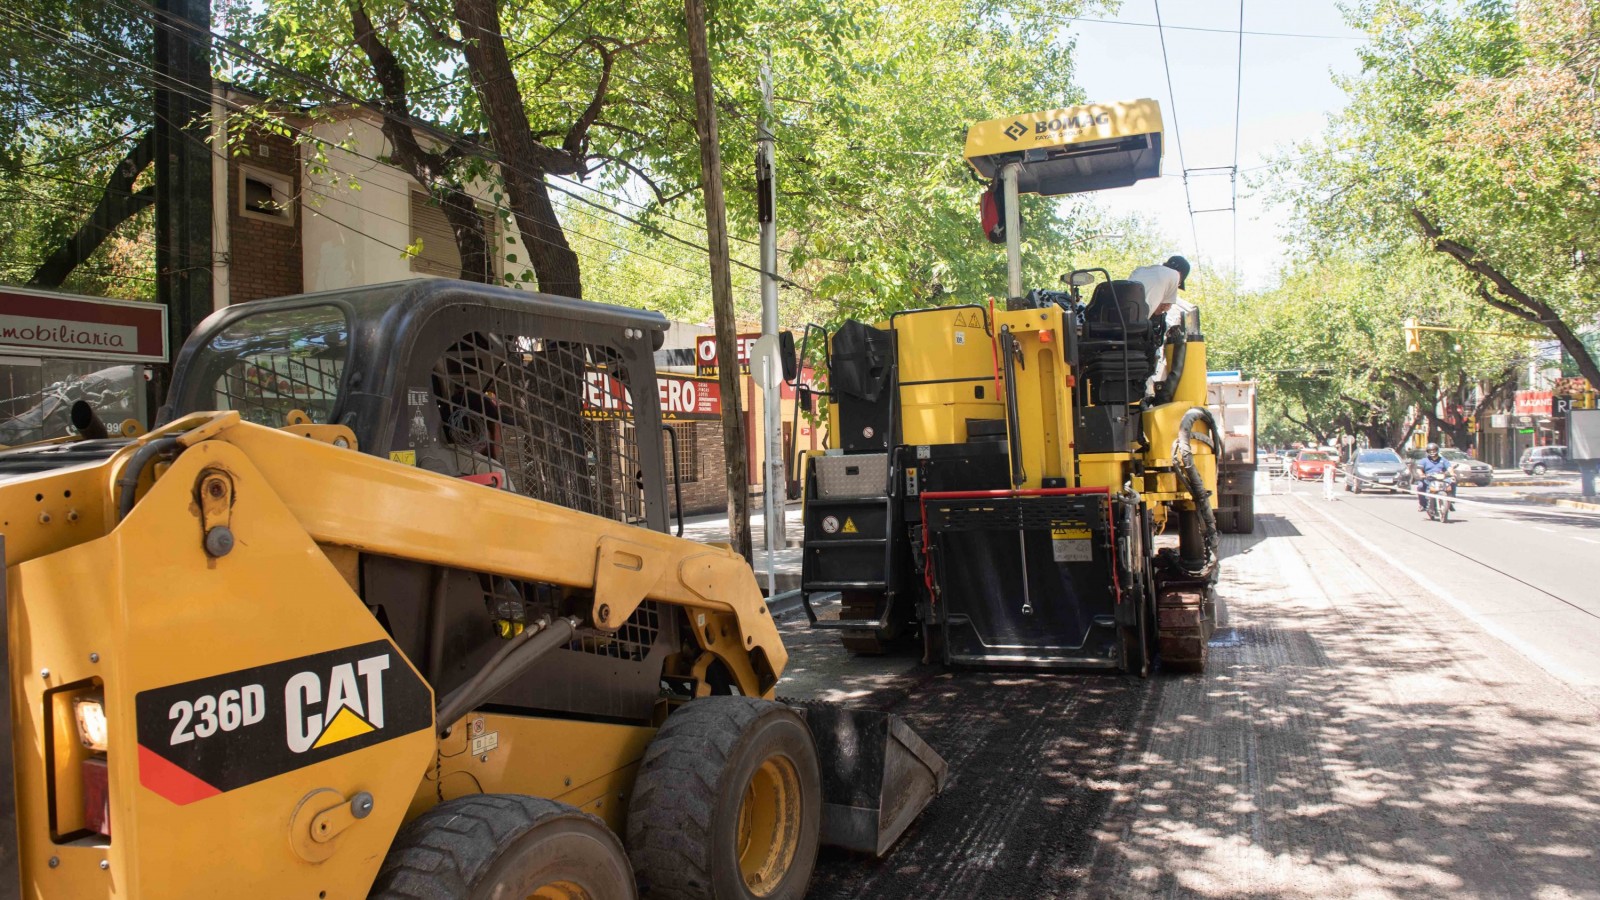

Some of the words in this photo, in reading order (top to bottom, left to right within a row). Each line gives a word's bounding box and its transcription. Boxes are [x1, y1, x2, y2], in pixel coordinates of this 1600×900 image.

[1035, 112, 1109, 134] BOMAG
[0, 325, 124, 347] mobiliaria
[168, 683, 266, 746] 236D
[284, 653, 390, 754] CAT
